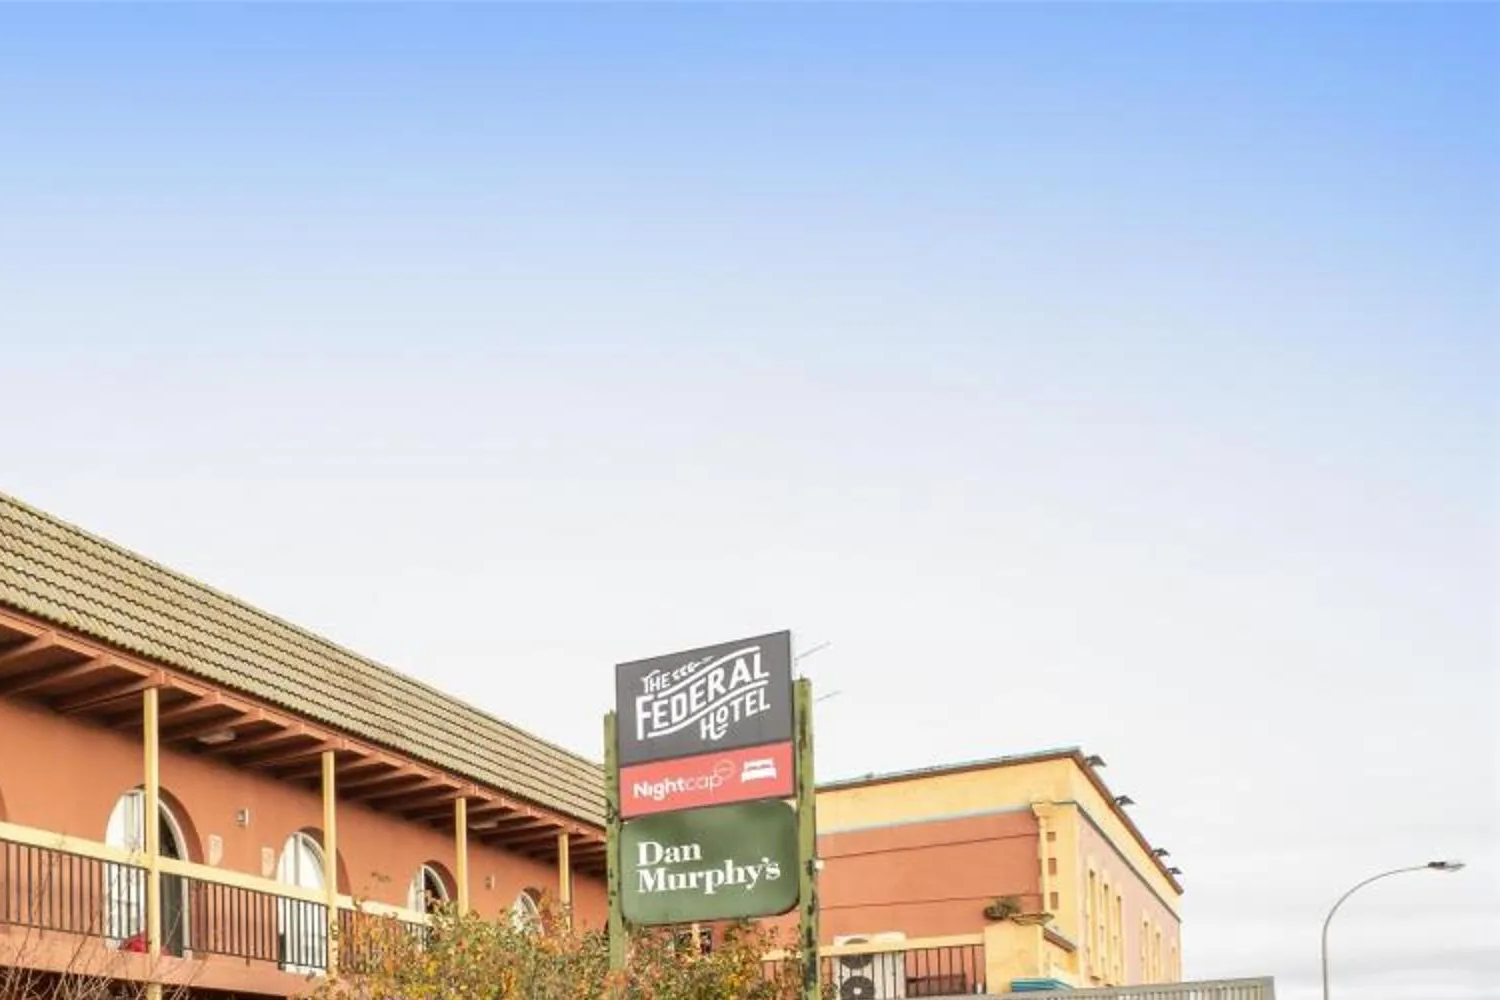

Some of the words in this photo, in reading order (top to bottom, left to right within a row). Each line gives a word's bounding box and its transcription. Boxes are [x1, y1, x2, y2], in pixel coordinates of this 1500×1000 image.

[635, 652, 770, 741] FEDERAL
[642, 669, 670, 694] THE
[701, 687, 771, 741] HOTEL
[633, 773, 724, 801] Nightcap
[636, 841, 702, 867] Dan
[636, 857, 781, 895] Murphy's
